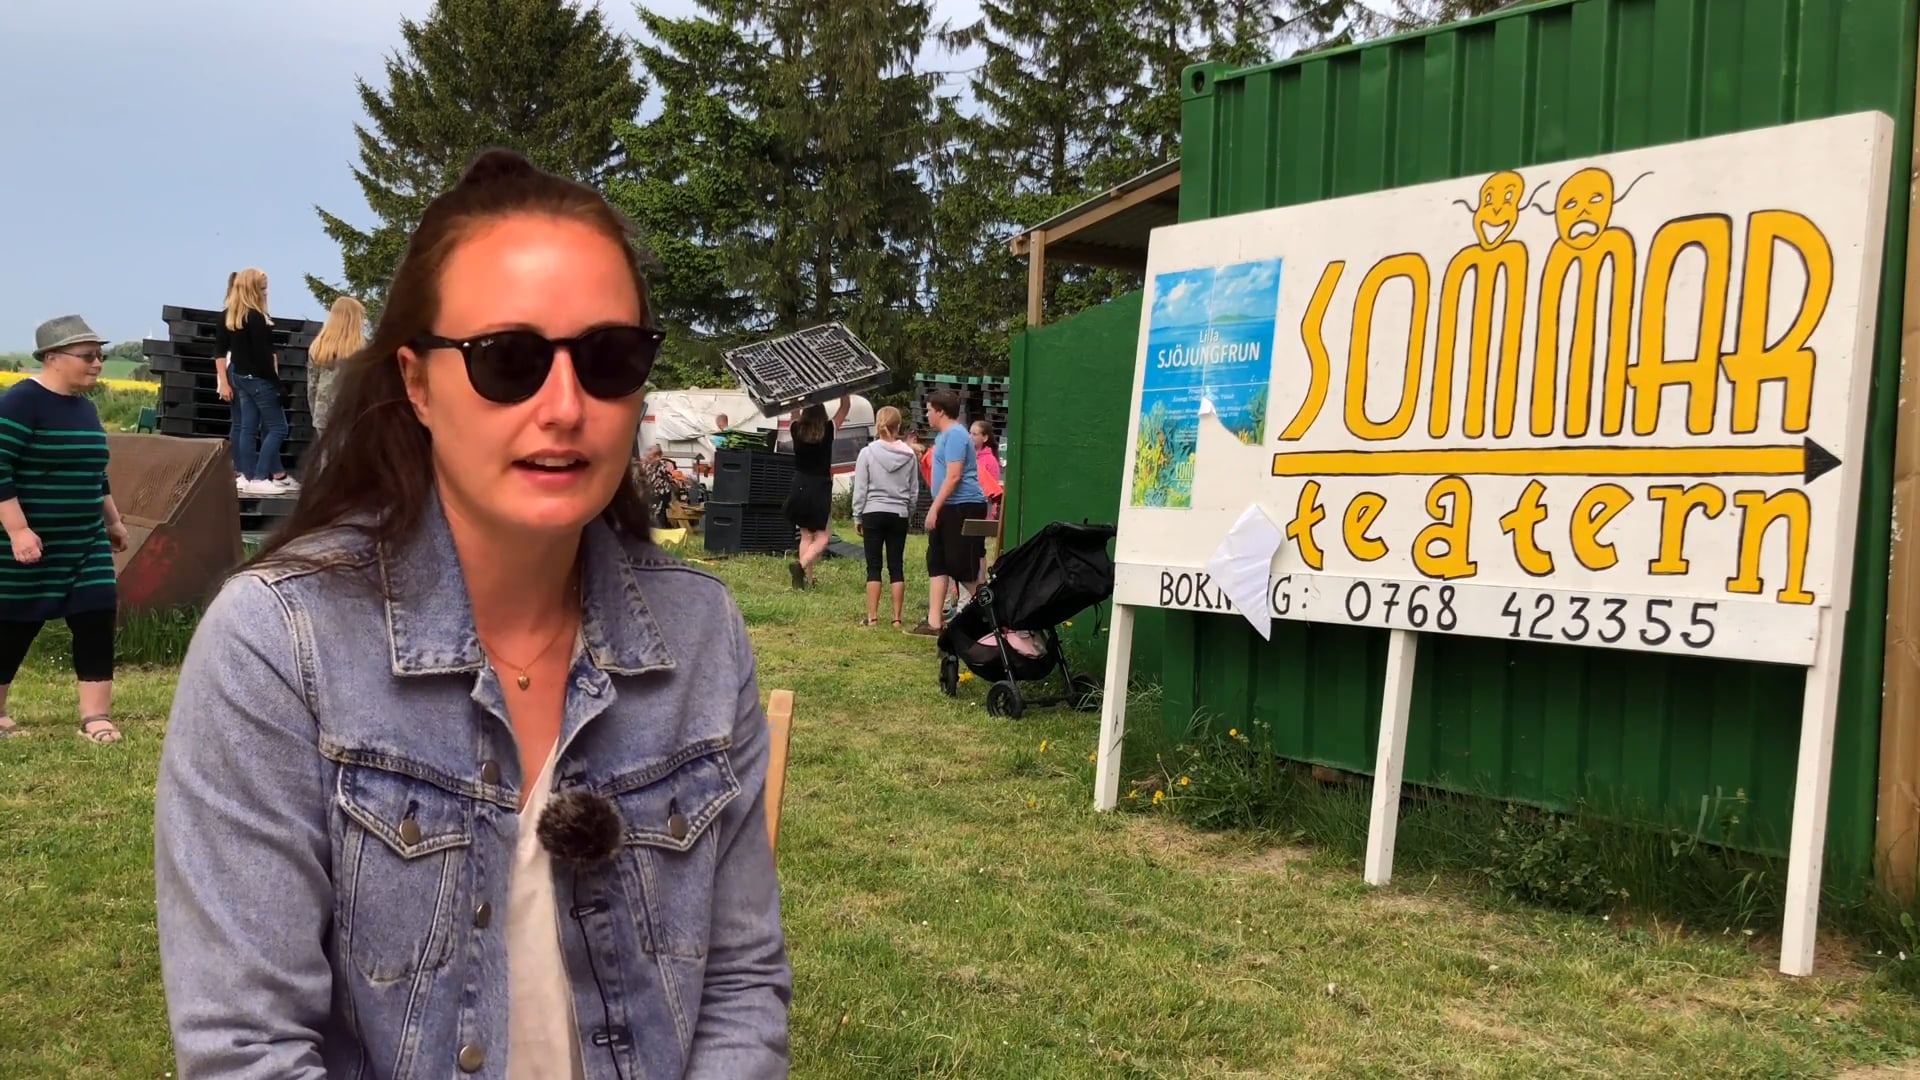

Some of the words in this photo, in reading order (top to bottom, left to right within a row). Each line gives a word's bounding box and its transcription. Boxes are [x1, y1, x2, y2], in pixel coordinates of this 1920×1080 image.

[1157, 341, 1260, 368] SJÖJUNGFRUN
[1199, 328, 1219, 343] Lilla
[1278, 209, 1834, 441] SOMMAR
[1285, 475, 1815, 605] teatern
[1345, 580, 1458, 631] 0768
[1501, 590, 1718, 648] 423355
